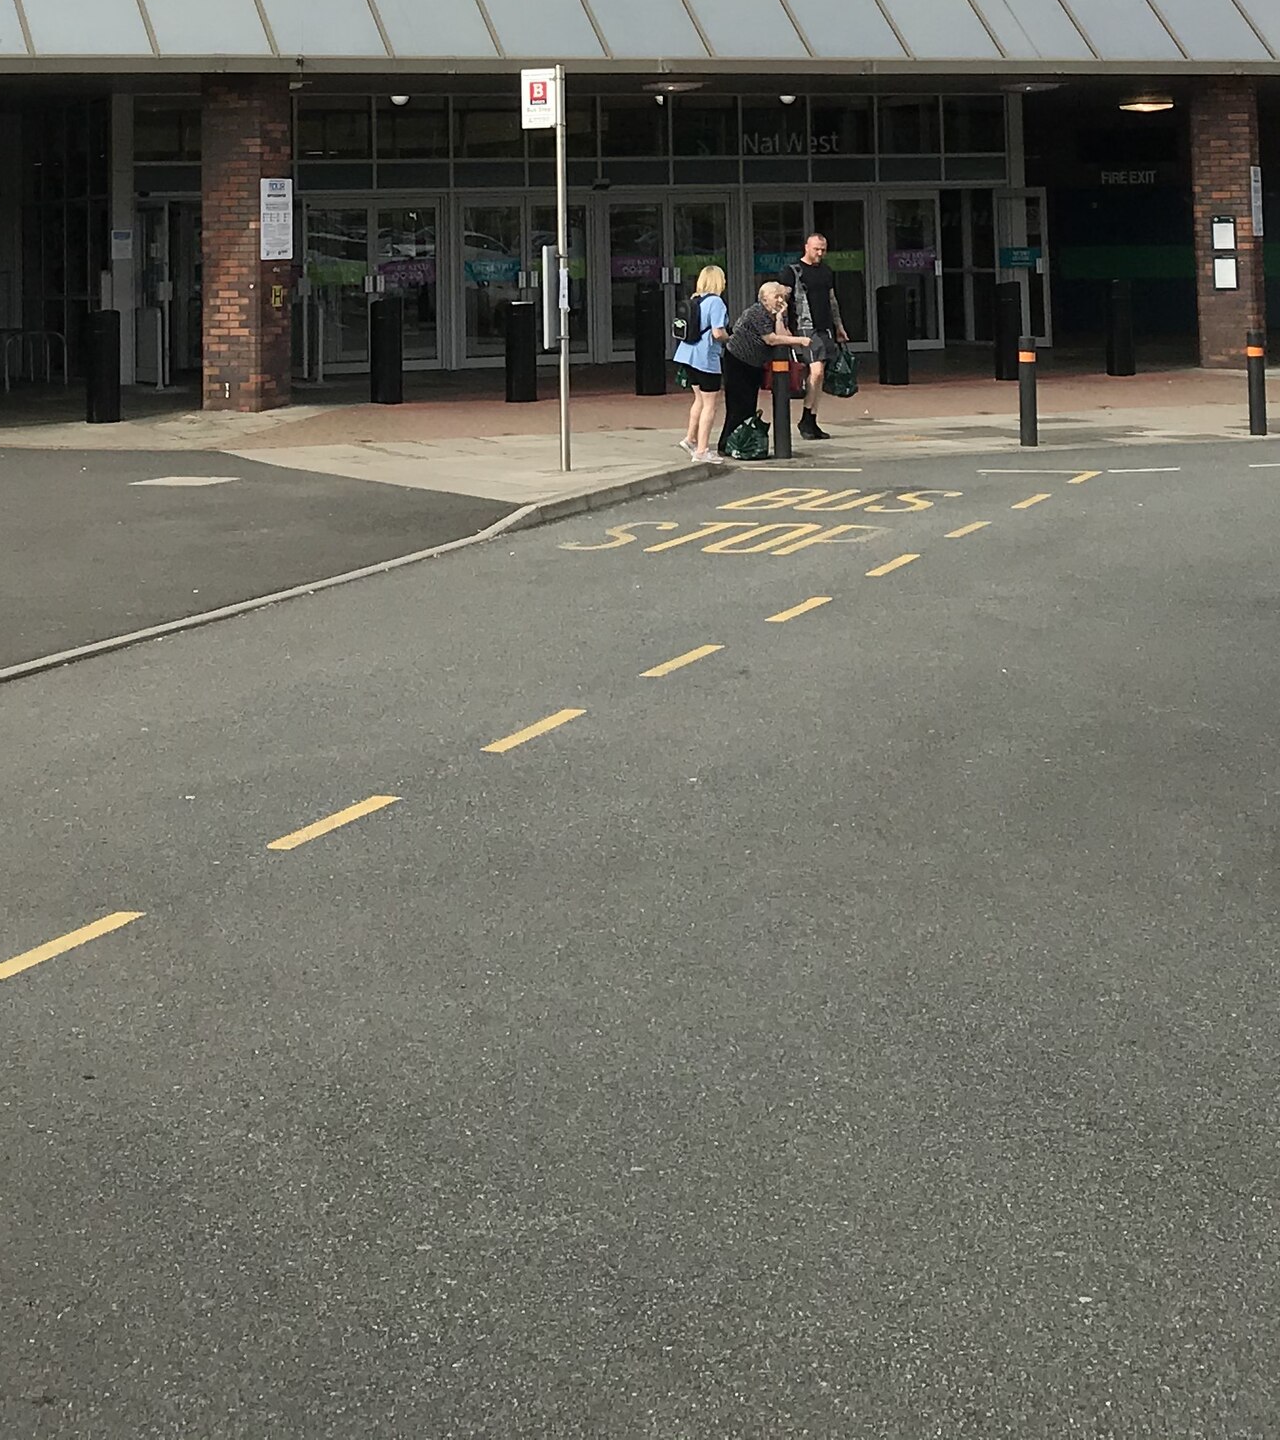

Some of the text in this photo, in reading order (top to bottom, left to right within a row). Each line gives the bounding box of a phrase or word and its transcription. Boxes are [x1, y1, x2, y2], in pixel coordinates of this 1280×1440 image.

[1100, 170, 1157, 184] FIRE EXIT
[716, 487, 963, 514] BUS
[558, 520, 892, 557] STOP
